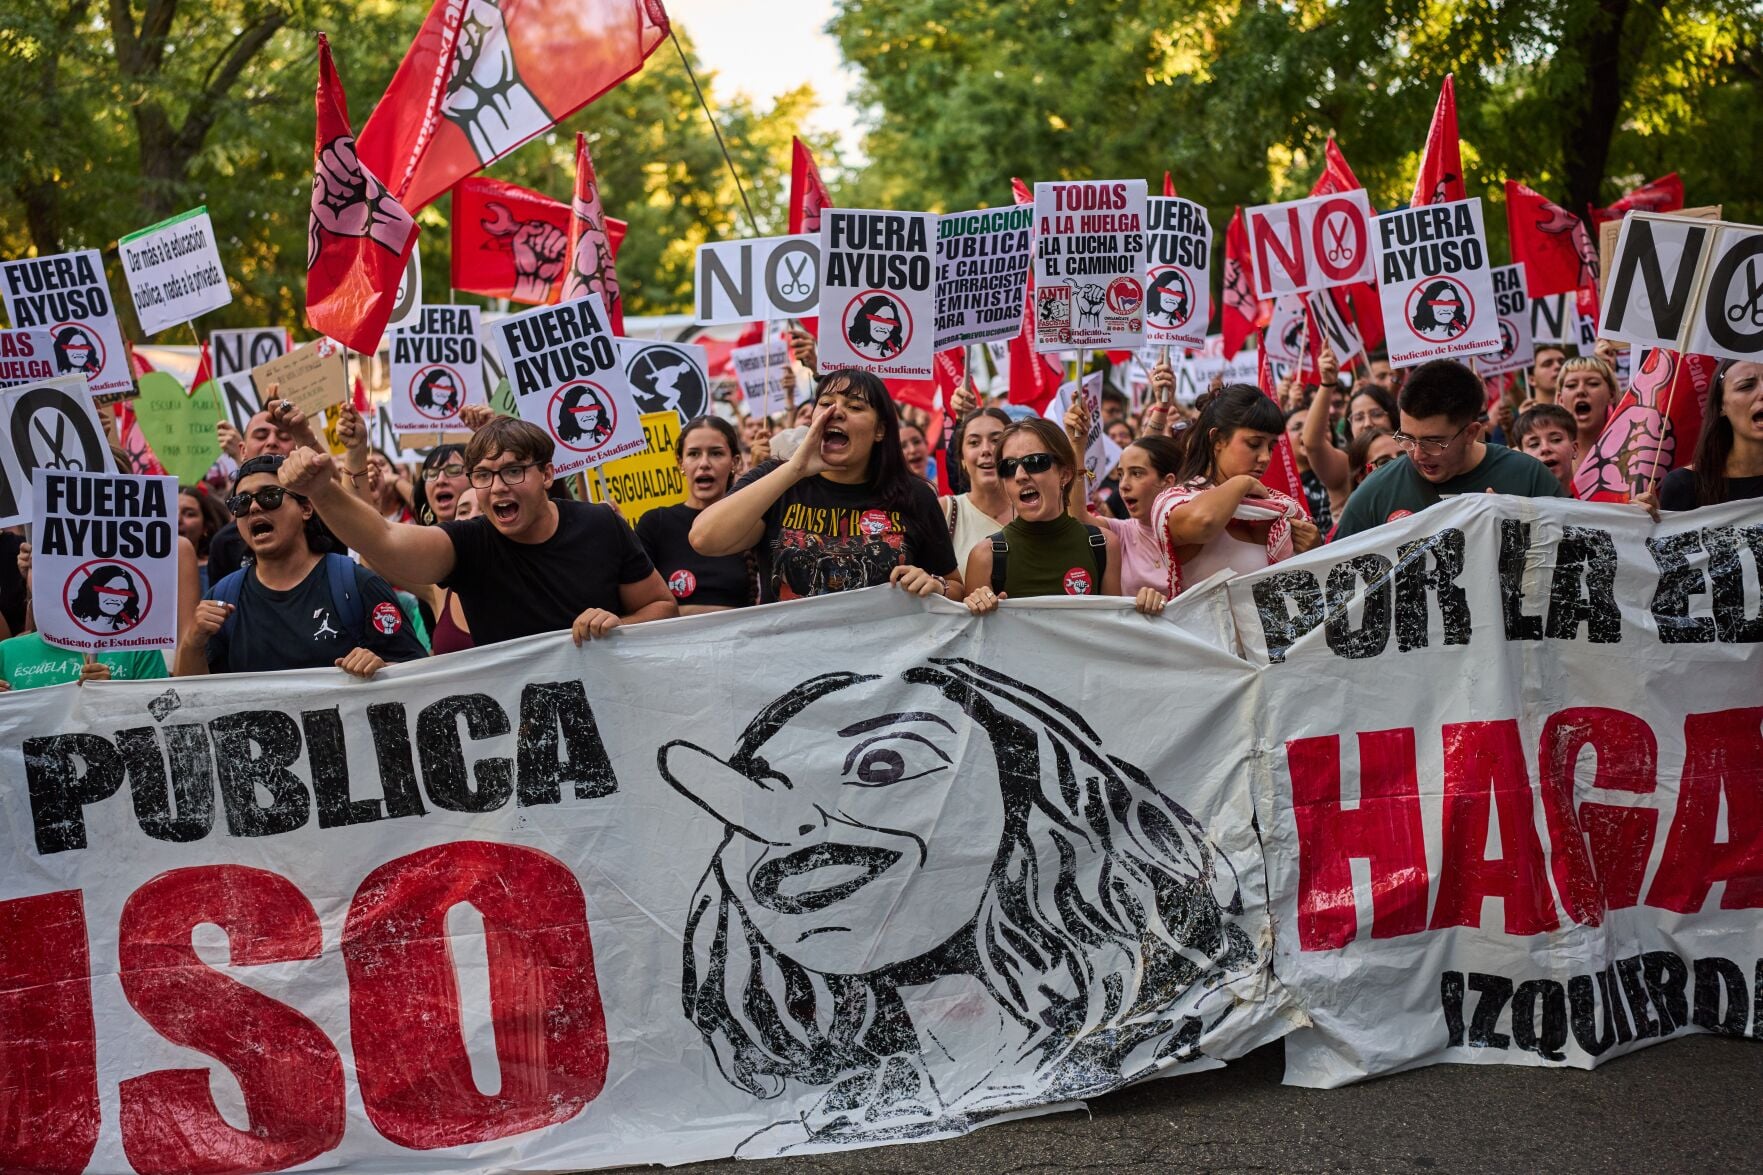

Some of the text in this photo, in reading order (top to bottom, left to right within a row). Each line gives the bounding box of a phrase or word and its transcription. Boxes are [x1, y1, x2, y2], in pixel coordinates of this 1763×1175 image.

[1053, 183, 1127, 212] TODAS
[830, 213, 927, 252] FUERA
[1040, 213, 1141, 236] A LA HUELGA
[1147, 200, 1206, 237] UERA
[1378, 203, 1475, 249] FUERA
[127, 224, 207, 272] Dar más a la educación
[1039, 233, 1143, 259] ¡LA LUCHA ES
[1146, 233, 1206, 270] YUSO
[1252, 198, 1367, 293] NO
[1383, 237, 1483, 285] AYUSO
[4, 254, 97, 297] FUERA
[701, 239, 820, 320] NO
[826, 252, 931, 291] AYUSO
[956, 253, 1029, 277] CALIDAD
[1046, 254, 1135, 276] EL CAMINO!
[134, 260, 222, 316] pública, nada a la privada.
[935, 270, 1028, 298] NTIRRACISTA
[1039, 288, 1068, 301] ANTI
[13, 286, 109, 328] AYUSO
[976, 303, 1022, 324] TODAS
[1038, 319, 1070, 327] FASCISTAS
[0, 332, 34, 357] AS
[502, 300, 603, 358] FUERA
[934, 324, 1020, 348] QUIERDA REVOLUCIONARIA
[1166, 333, 1204, 344] Estudiantes
[394, 337, 477, 364] AYUSO
[513, 335, 615, 396] AYUSO
[866, 362, 877, 372] de
[878, 363, 932, 375] Estudiantes
[1391, 339, 1499, 363] Sindicato de Estudiantes
[89, 380, 131, 392] studiantes
[654, 423, 674, 452] LA
[554, 459, 585, 475] ndicato
[585, 454, 598, 464] de
[598, 438, 645, 460] Estudiantes
[1278, 434, 1300, 498] Estudia
[46, 475, 168, 518] FUERA
[782, 503, 826, 533] GUNS
[41, 517, 172, 559] AYUSO
[1251, 526, 1472, 664] POR
[1498, 518, 1621, 643] LA
[44, 631, 174, 649] Sindicato de Estudiantes
[14, 660, 67, 677] ESCUELA
[22, 679, 618, 856] PÚBLICA
[1440, 950, 1763, 1061] IZQUIERD
